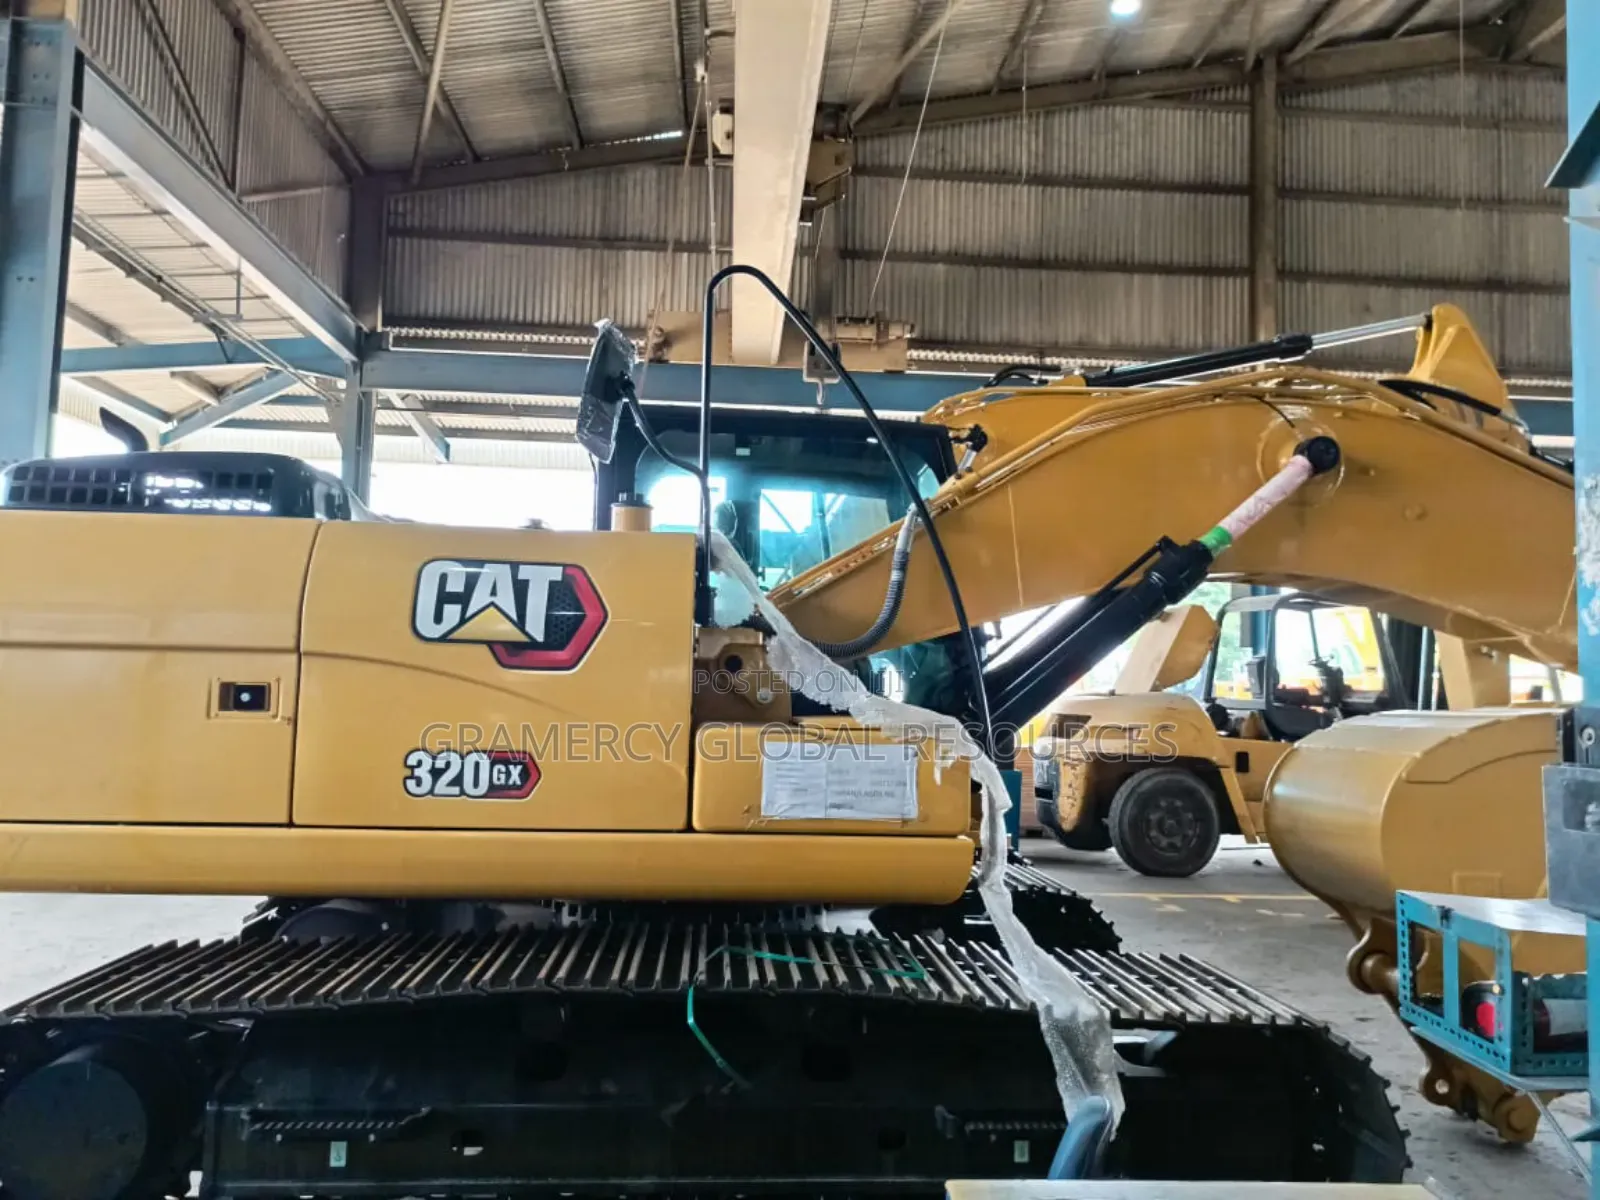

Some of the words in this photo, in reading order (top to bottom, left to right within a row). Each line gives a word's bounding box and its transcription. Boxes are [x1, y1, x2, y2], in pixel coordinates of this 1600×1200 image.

[414, 559, 564, 643] CAT
[405, 751, 490, 797] 320
[492, 764, 523, 786] GX
